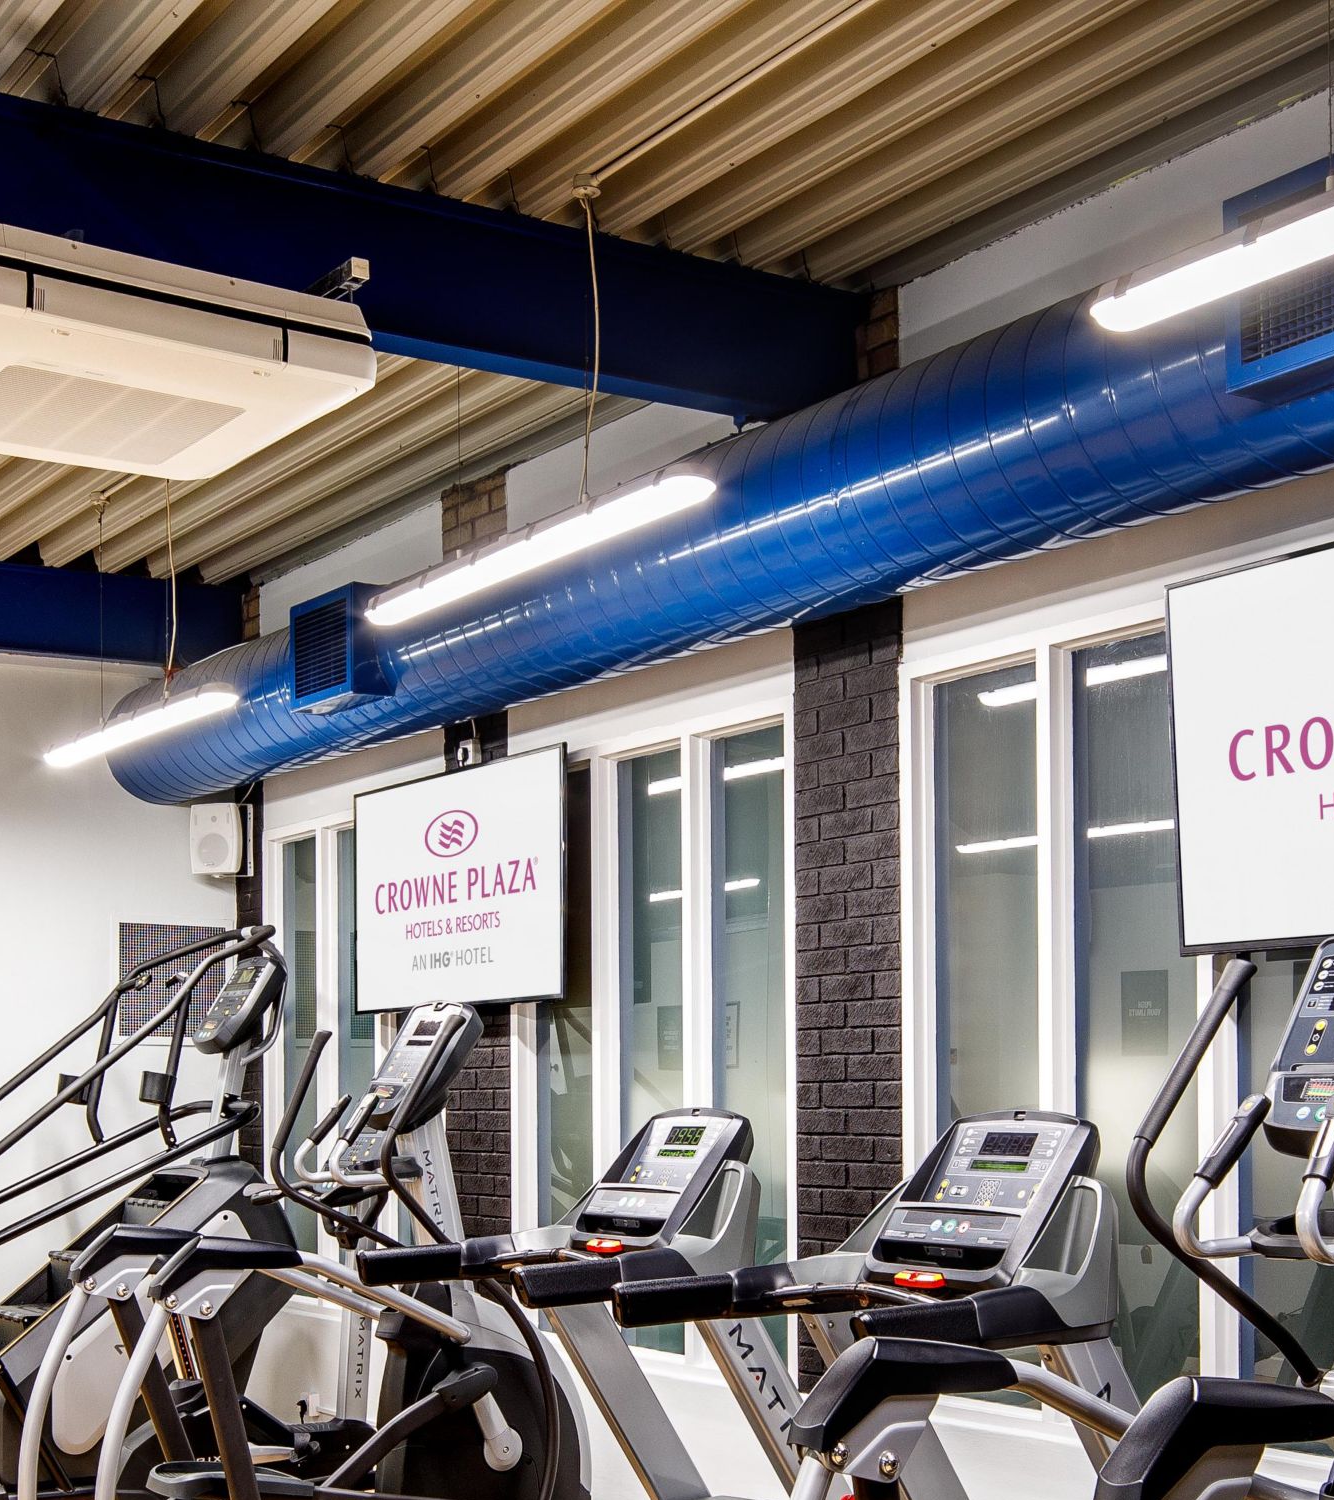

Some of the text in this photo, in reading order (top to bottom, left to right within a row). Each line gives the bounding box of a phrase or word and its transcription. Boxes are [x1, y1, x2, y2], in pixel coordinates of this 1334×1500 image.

[375, 870, 458, 915] CROWNE
[405, 911, 501, 940] HOTELS & RESORTS
[411, 954, 427, 972] AN
[455, 946, 494, 966] HOTEL
[423, 1149, 446, 1234] MATRI
[354, 1316, 366, 1399] MATRIX
